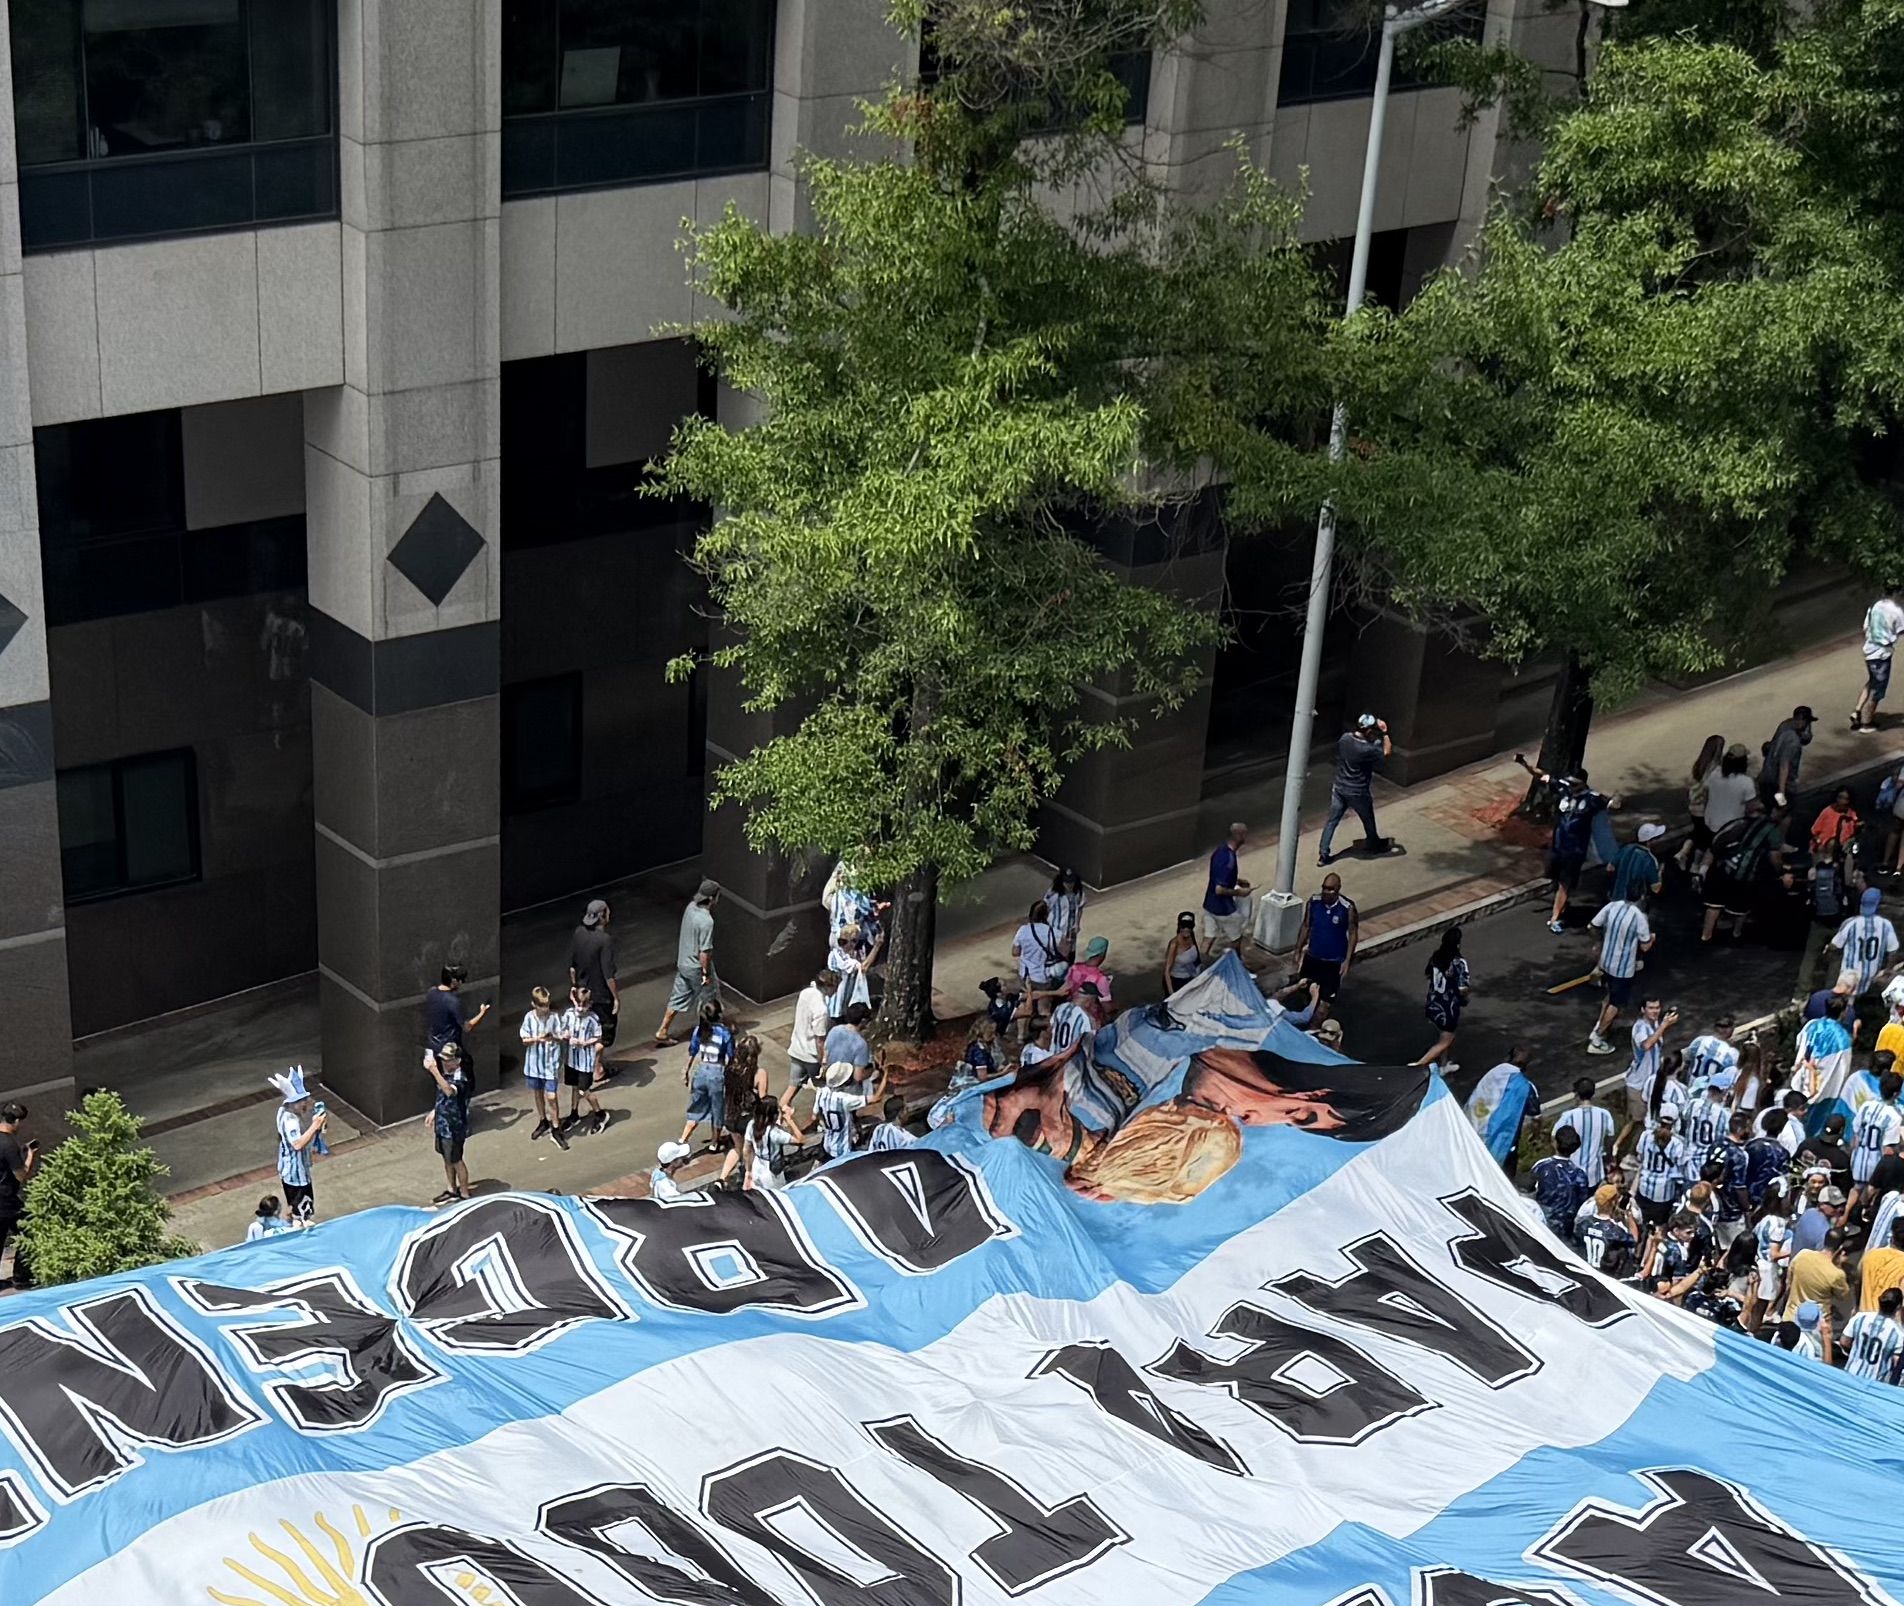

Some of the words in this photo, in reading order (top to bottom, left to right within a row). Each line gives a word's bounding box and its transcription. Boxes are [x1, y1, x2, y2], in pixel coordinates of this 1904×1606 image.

[1858, 935, 1879, 962] 10
[1053, 1019, 1071, 1049] 10
[1692, 1116, 1713, 1144] 10
[1860, 1120, 1882, 1151] 10
[1646, 1150, 1666, 1173] 10
[1027, 1187, 1637, 1476] PARA
[1861, 1332, 1882, 1364] 10
